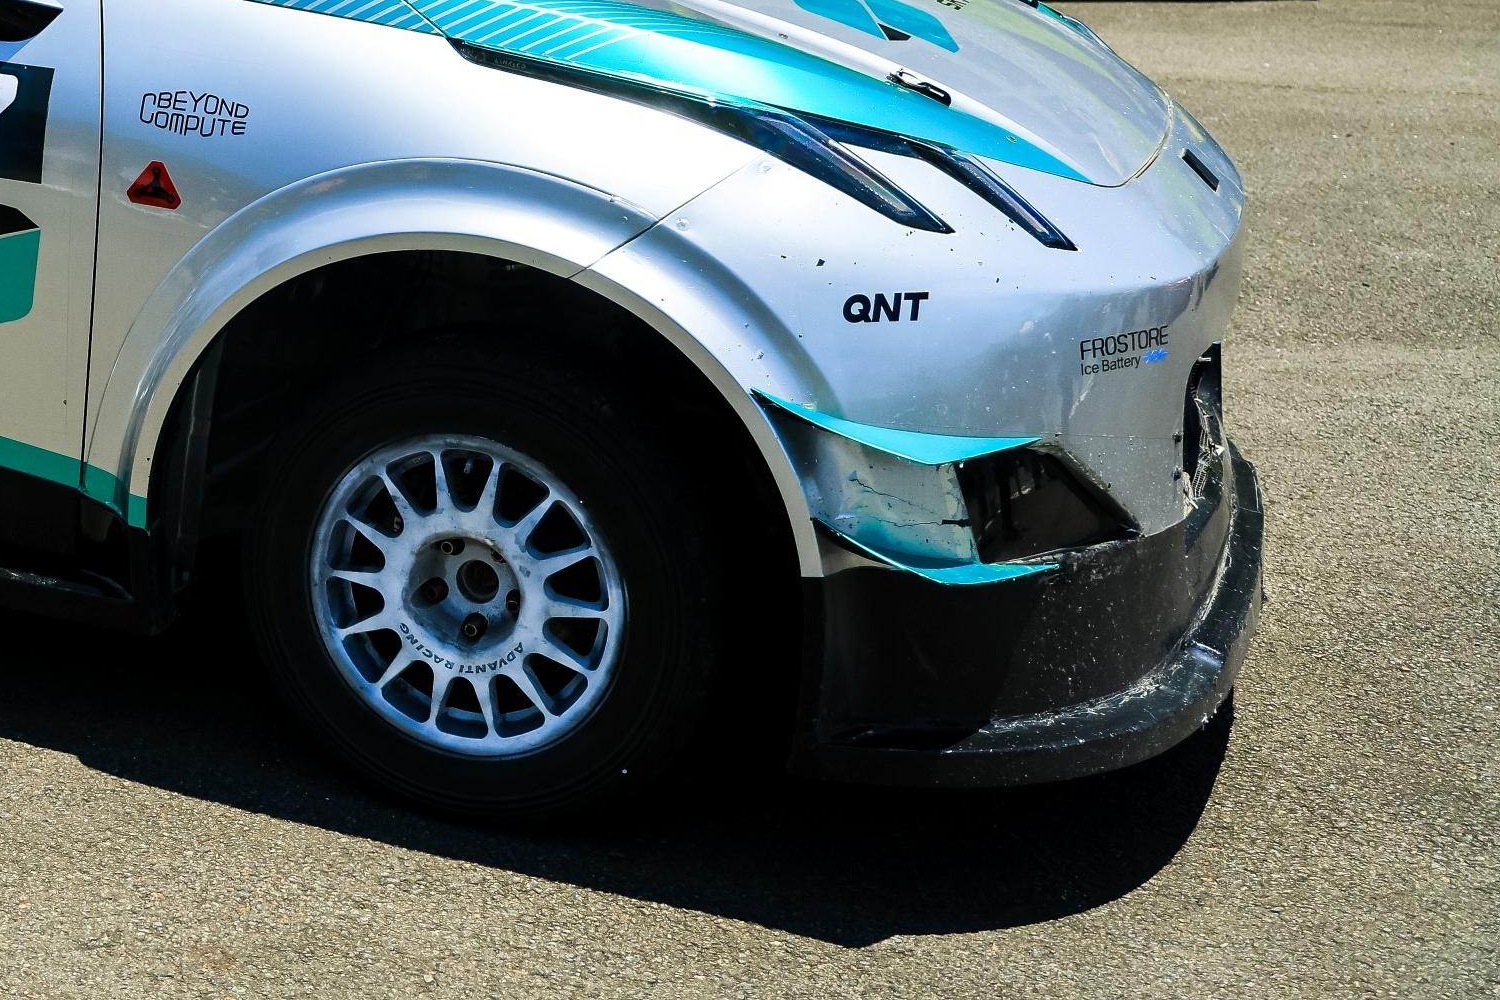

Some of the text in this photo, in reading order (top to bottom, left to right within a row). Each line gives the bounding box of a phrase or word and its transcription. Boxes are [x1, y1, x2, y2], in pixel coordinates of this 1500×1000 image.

[139, 92, 248, 137] COMPUTE
[157, 90, 249, 119] BEYOND
[842, 291, 930, 324] QNT
[1080, 324, 1169, 361] FROSTORE
[1080, 355, 1142, 377] Ice Battery
